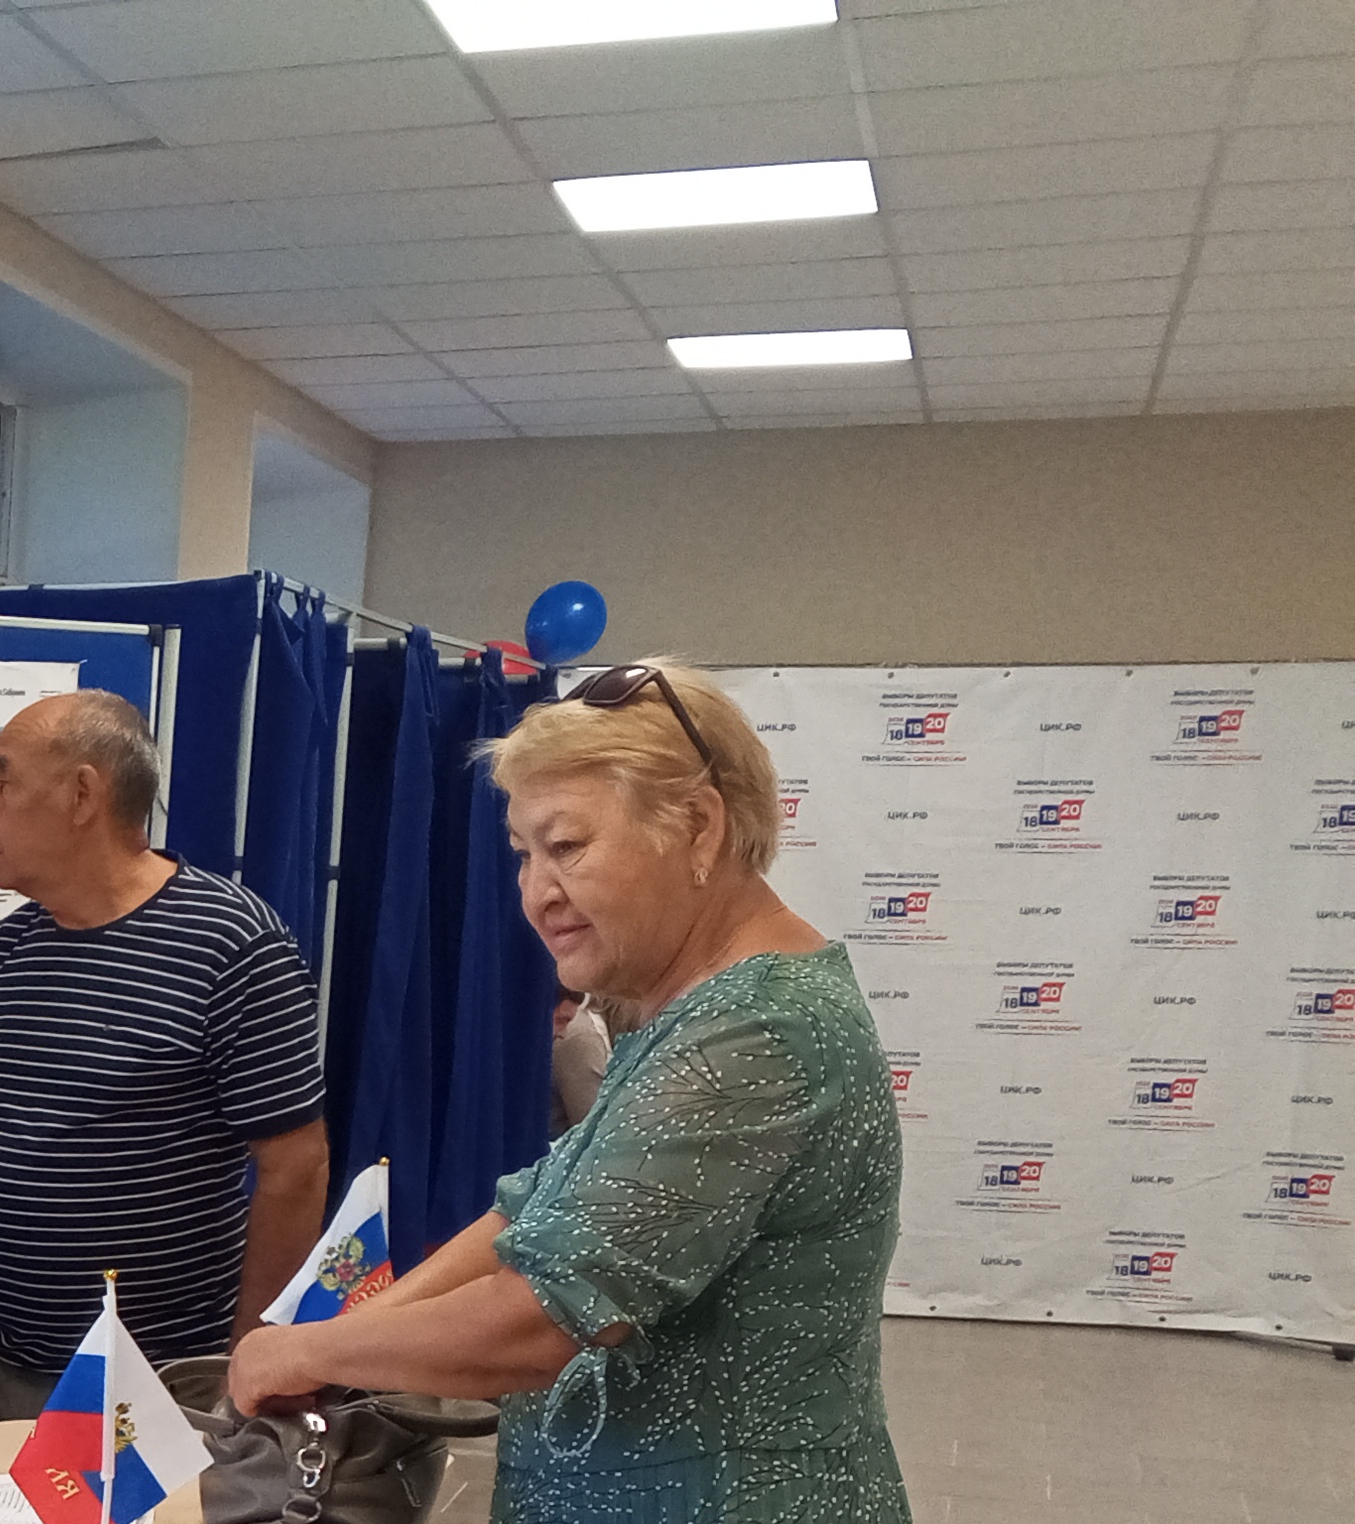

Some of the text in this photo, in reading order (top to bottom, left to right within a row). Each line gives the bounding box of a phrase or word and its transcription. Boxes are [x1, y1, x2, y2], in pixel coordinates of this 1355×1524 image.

[890, 717, 944, 740] 18 19 20
[1182, 715, 1240, 739] 18 19 20
[1024, 804, 1081, 827] 18 19 20
[1322, 817, 1338, 828] 18
[872, 897, 926, 919] 18 19 20
[1159, 900, 1215, 922] 18 19 20
[1003, 987, 1059, 1008] 18 19 20
[1297, 994, 1354, 1015] 18 19 20
[1136, 1082, 1192, 1104] 18 19 20
[984, 1166, 1040, 1186] 18 19 20
[1273, 1179, 1329, 1198] 18 19 20
[1115, 1256, 1171, 1276] 18 19 20
